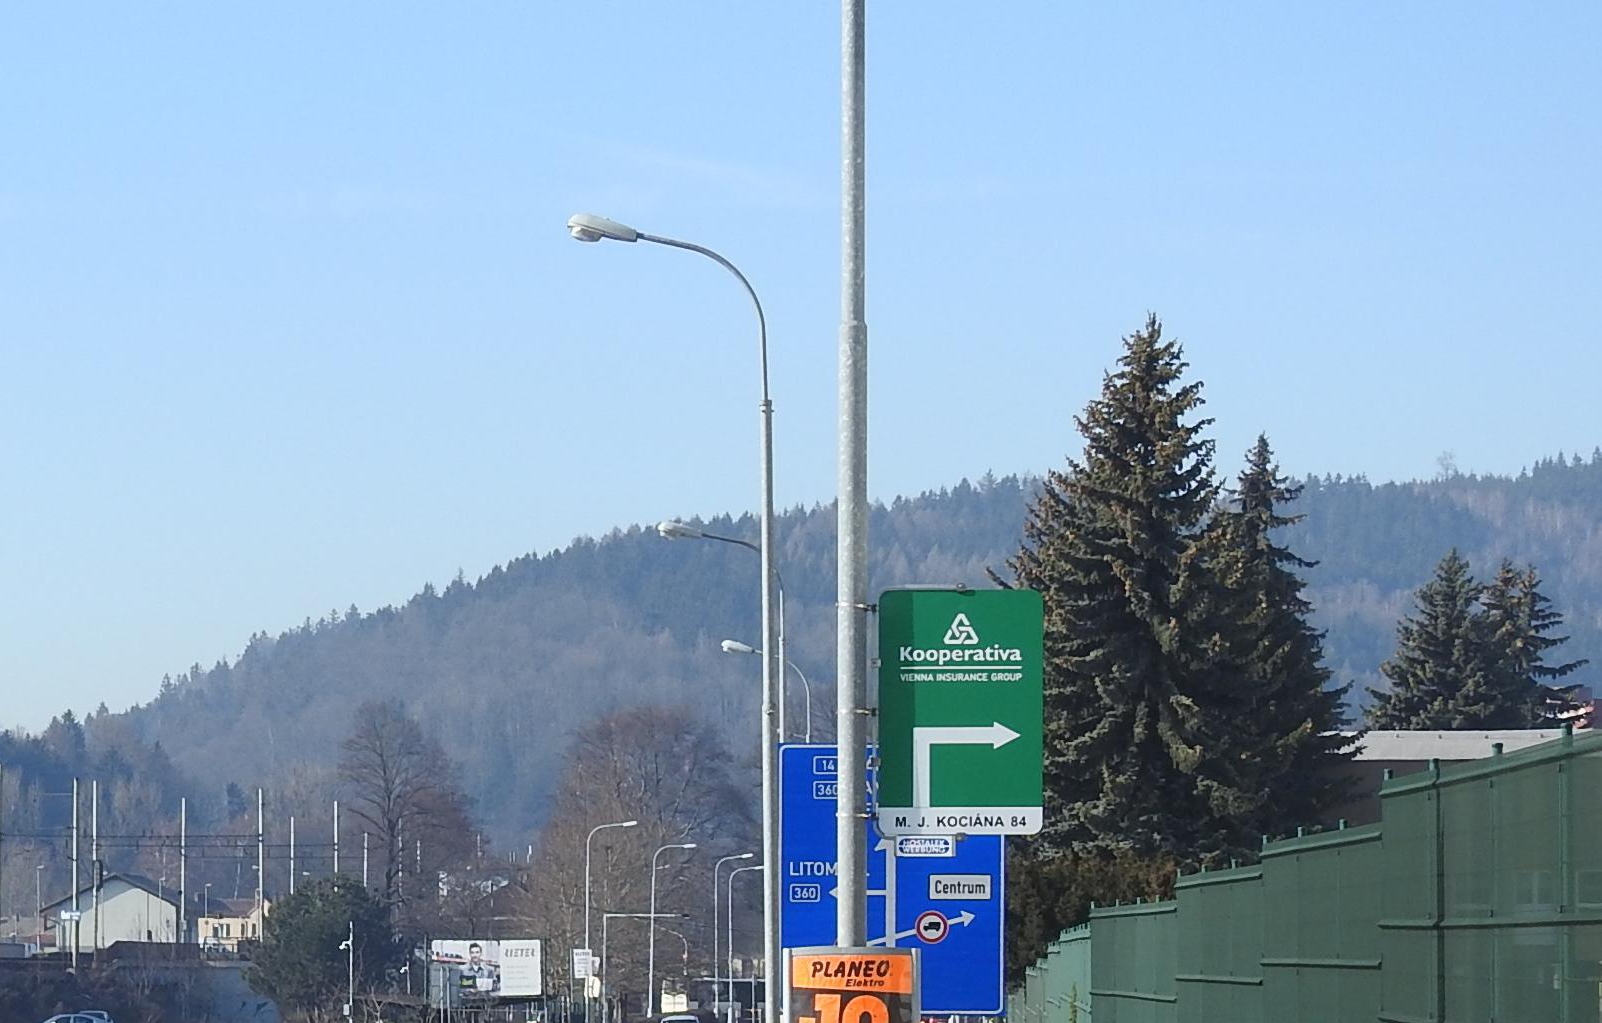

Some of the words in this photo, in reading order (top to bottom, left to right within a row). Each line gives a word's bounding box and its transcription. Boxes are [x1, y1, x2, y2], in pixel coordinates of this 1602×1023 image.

[899, 644, 1023, 665] Kooperativa
[900, 673, 934, 682] VIENNA
[936, 673, 988, 682] INSURANCE
[991, 673, 1022, 682] GROUP
[822, 760, 835, 771] 14
[817, 783, 838, 796] 360
[895, 817, 910, 828] M.
[918, 817, 929, 828] J.
[937, 812, 1004, 828] KOCIÁNA
[1011, 816, 1027, 828] 84
[789, 861, 870, 877] LITOM
[794, 887, 816, 899] 360
[934, 880, 986, 894] Centrum
[811, 960, 890, 978] PLANEO
[845, 979, 885, 987] Elektro
